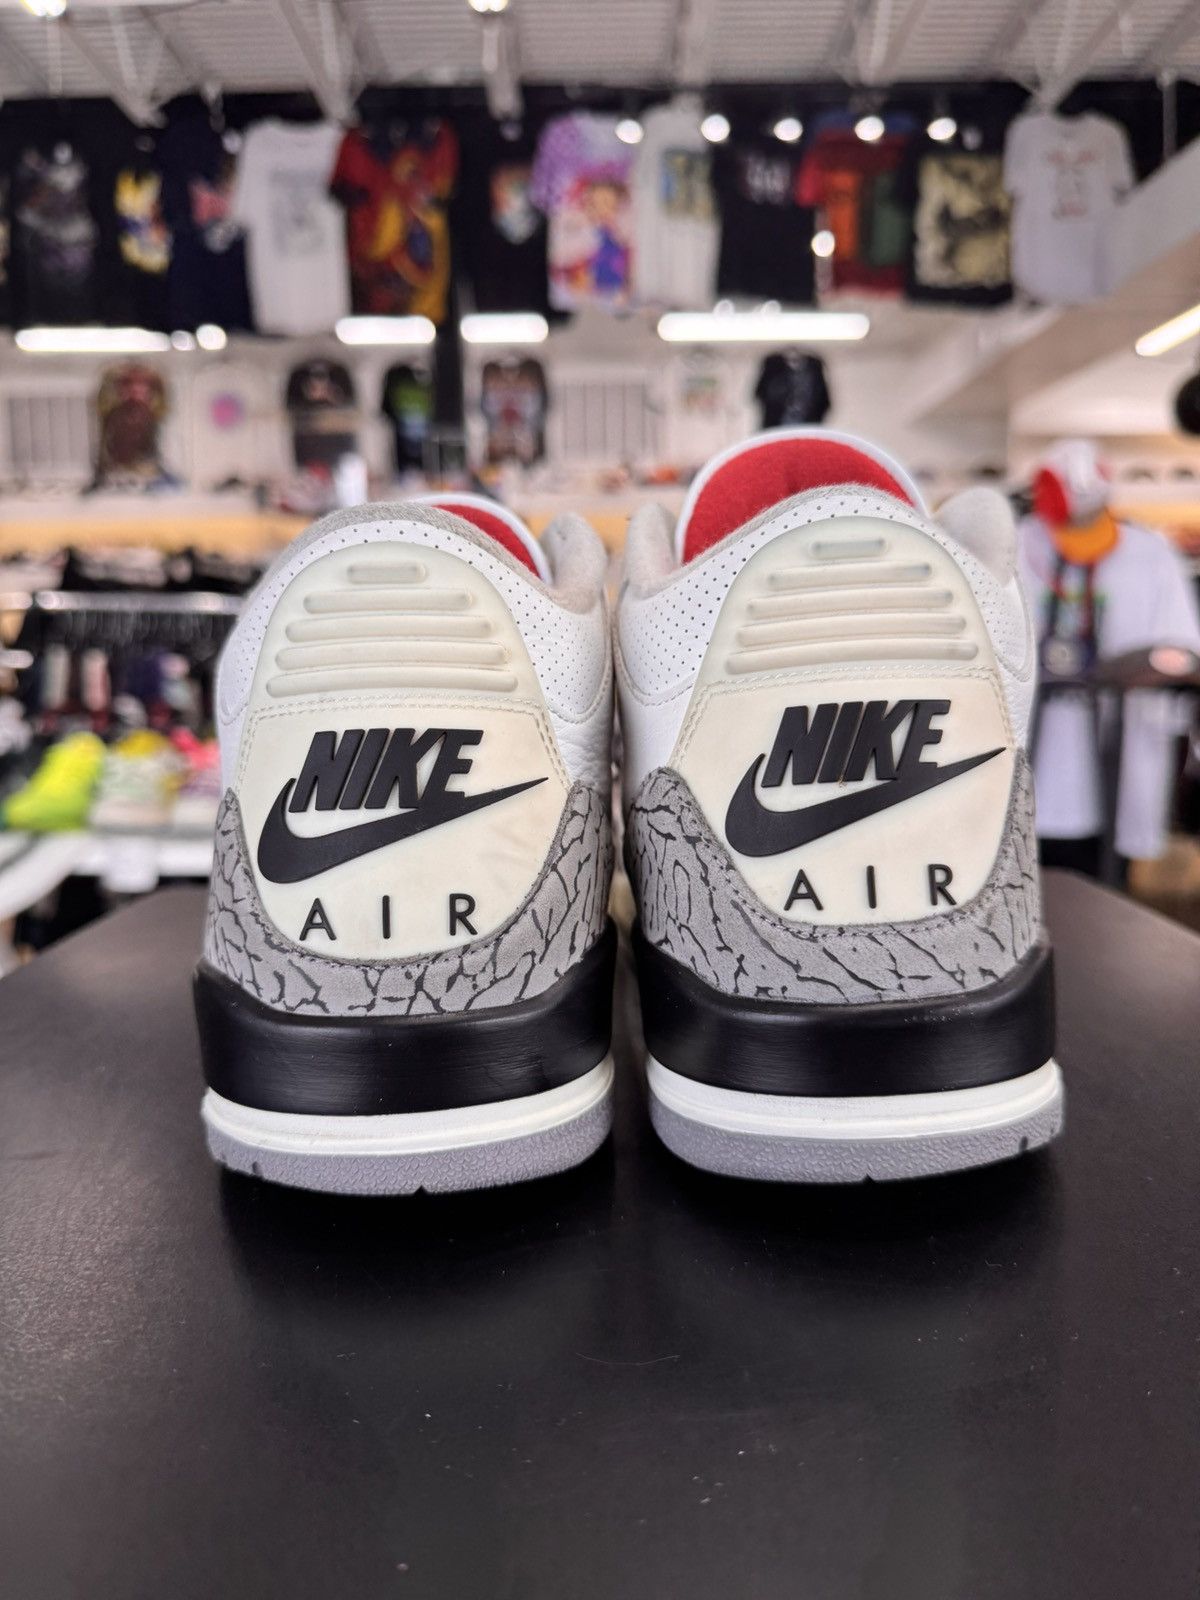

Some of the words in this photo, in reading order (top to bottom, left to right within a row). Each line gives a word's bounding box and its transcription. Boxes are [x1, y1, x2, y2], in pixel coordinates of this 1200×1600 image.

[288, 727, 484, 813] NIKE
[760, 699, 952, 788] NIKE
[299, 892, 479, 941] AIR
[783, 863, 957, 911] AIR
